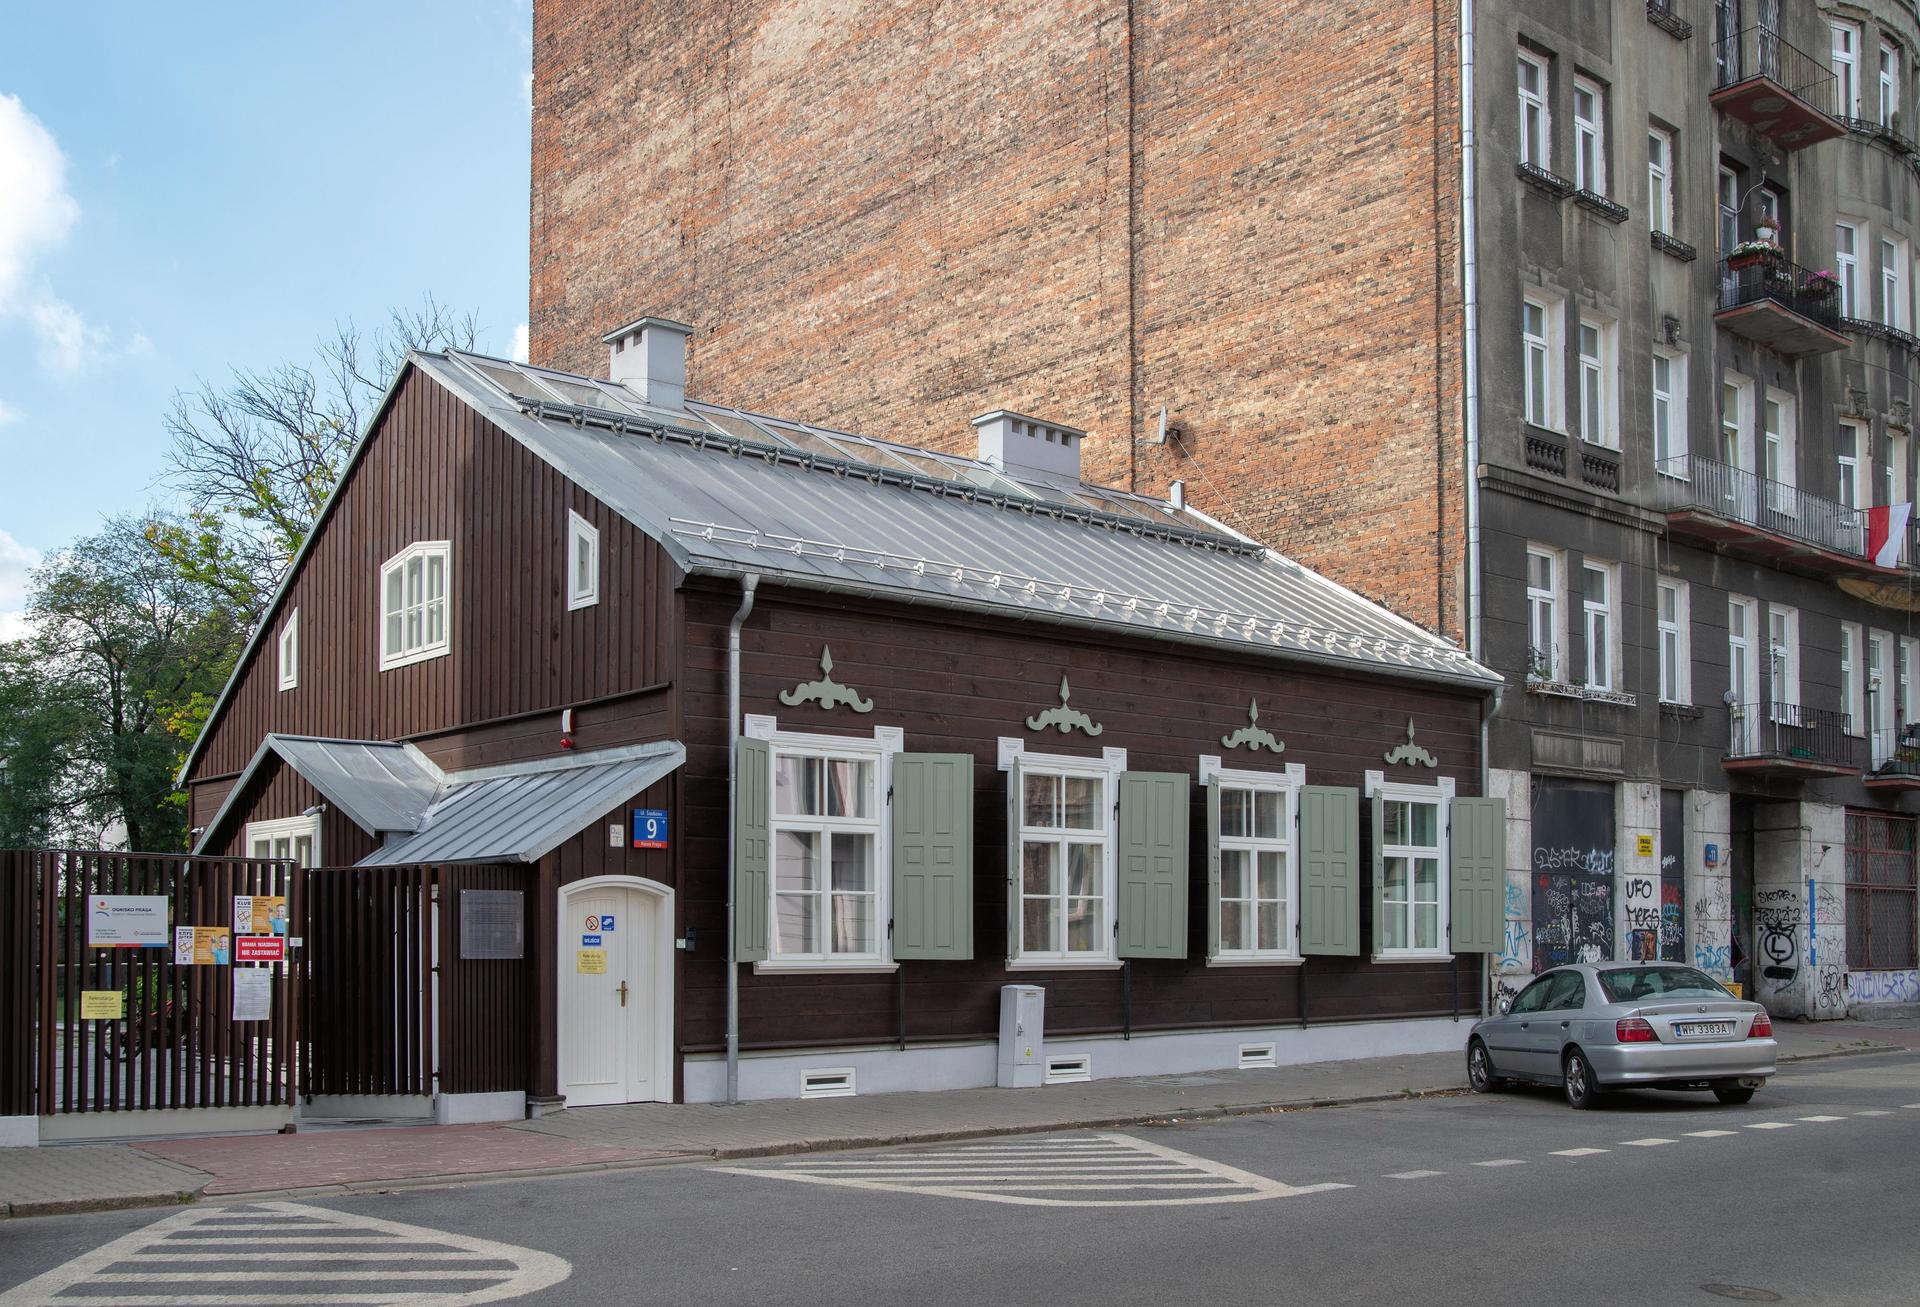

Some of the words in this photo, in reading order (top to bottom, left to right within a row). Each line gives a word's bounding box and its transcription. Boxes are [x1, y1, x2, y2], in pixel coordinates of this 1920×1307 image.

[647, 818, 657, 839] 9
[1626, 878, 1652, 899] UFO
[1681, 1025, 1695, 1034] WH
[1697, 1024, 1727, 1034] 3383A
